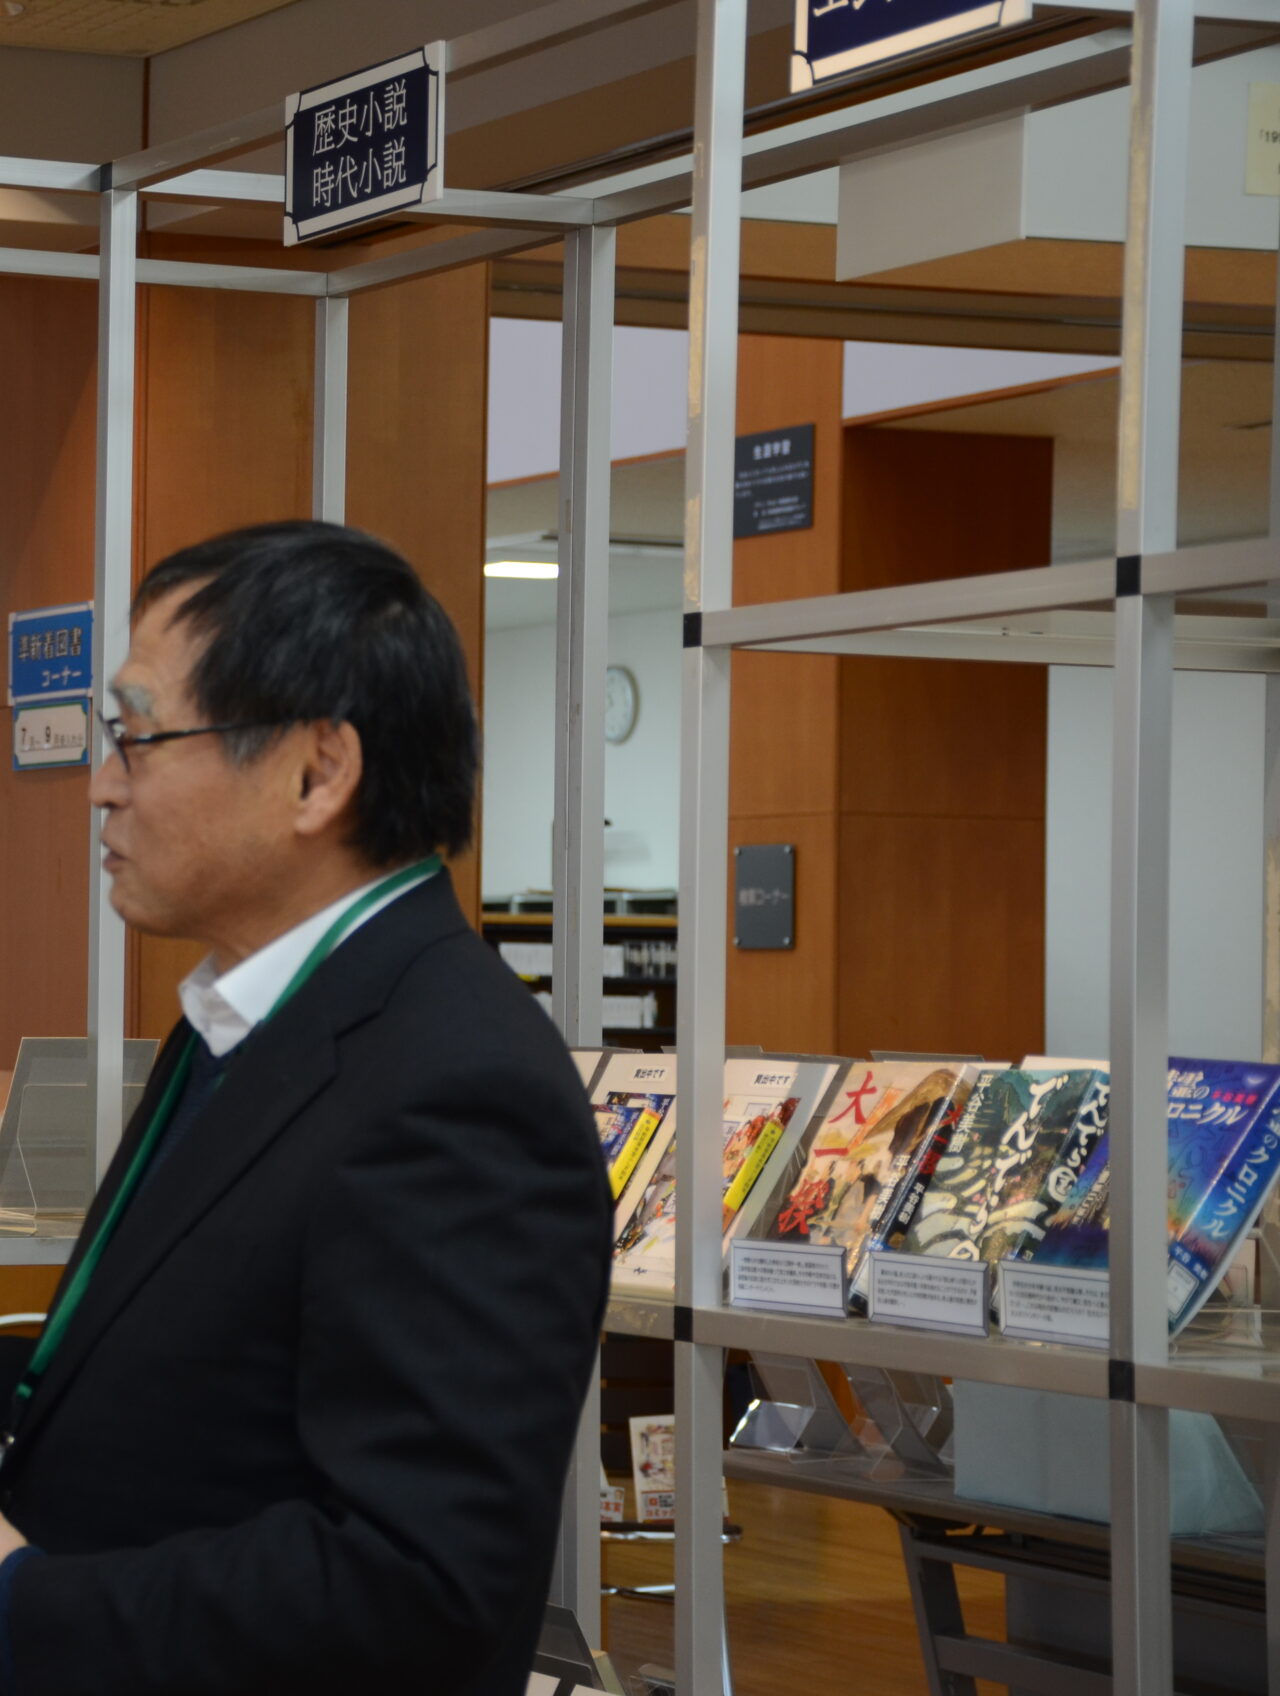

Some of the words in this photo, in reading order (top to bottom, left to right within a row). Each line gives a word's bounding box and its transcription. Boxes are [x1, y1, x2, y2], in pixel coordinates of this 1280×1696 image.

[312, 79, 408, 157] 歴史小説
[312, 136, 407, 207] 時代小説
[41, 666, 82, 688] コーナー
